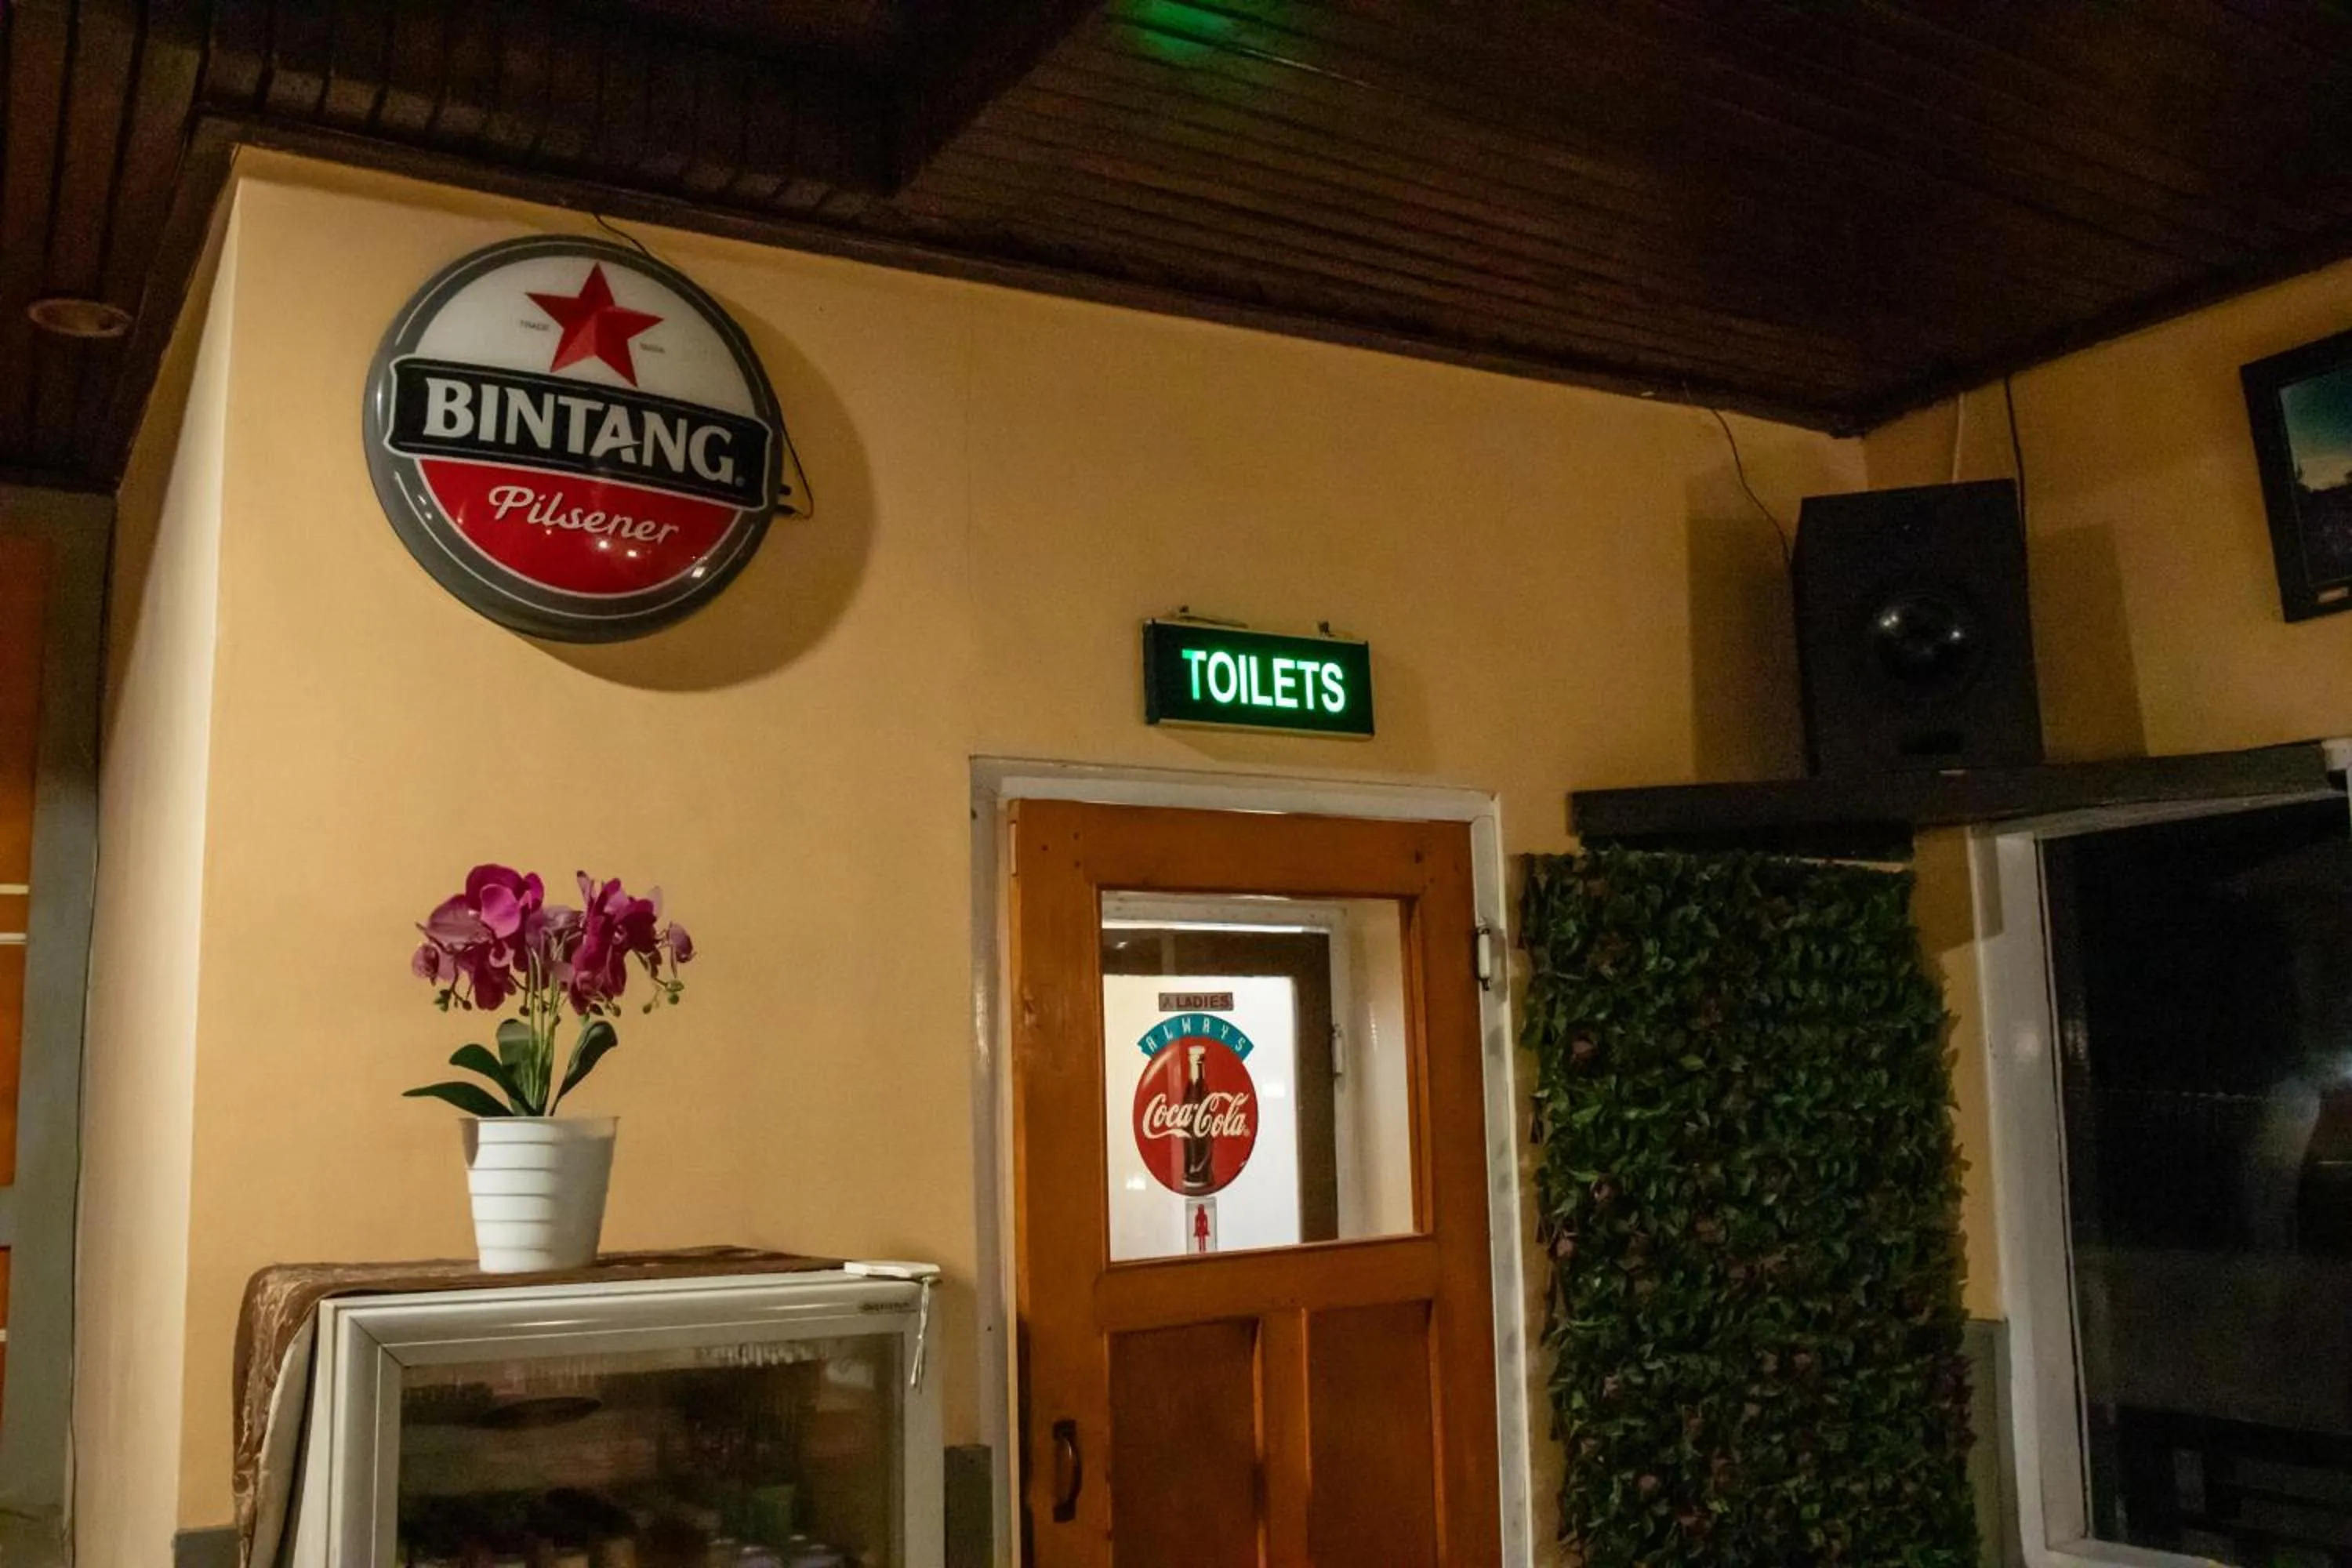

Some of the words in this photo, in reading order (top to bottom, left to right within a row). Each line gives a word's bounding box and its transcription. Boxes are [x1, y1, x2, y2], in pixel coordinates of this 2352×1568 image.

[488, 485, 680, 543] Pilsener
[1181, 649, 1346, 713] TOILETS
[1176, 995, 1230, 1008] LADIES
[1145, 1016, 1247, 1053] ALWAYS
